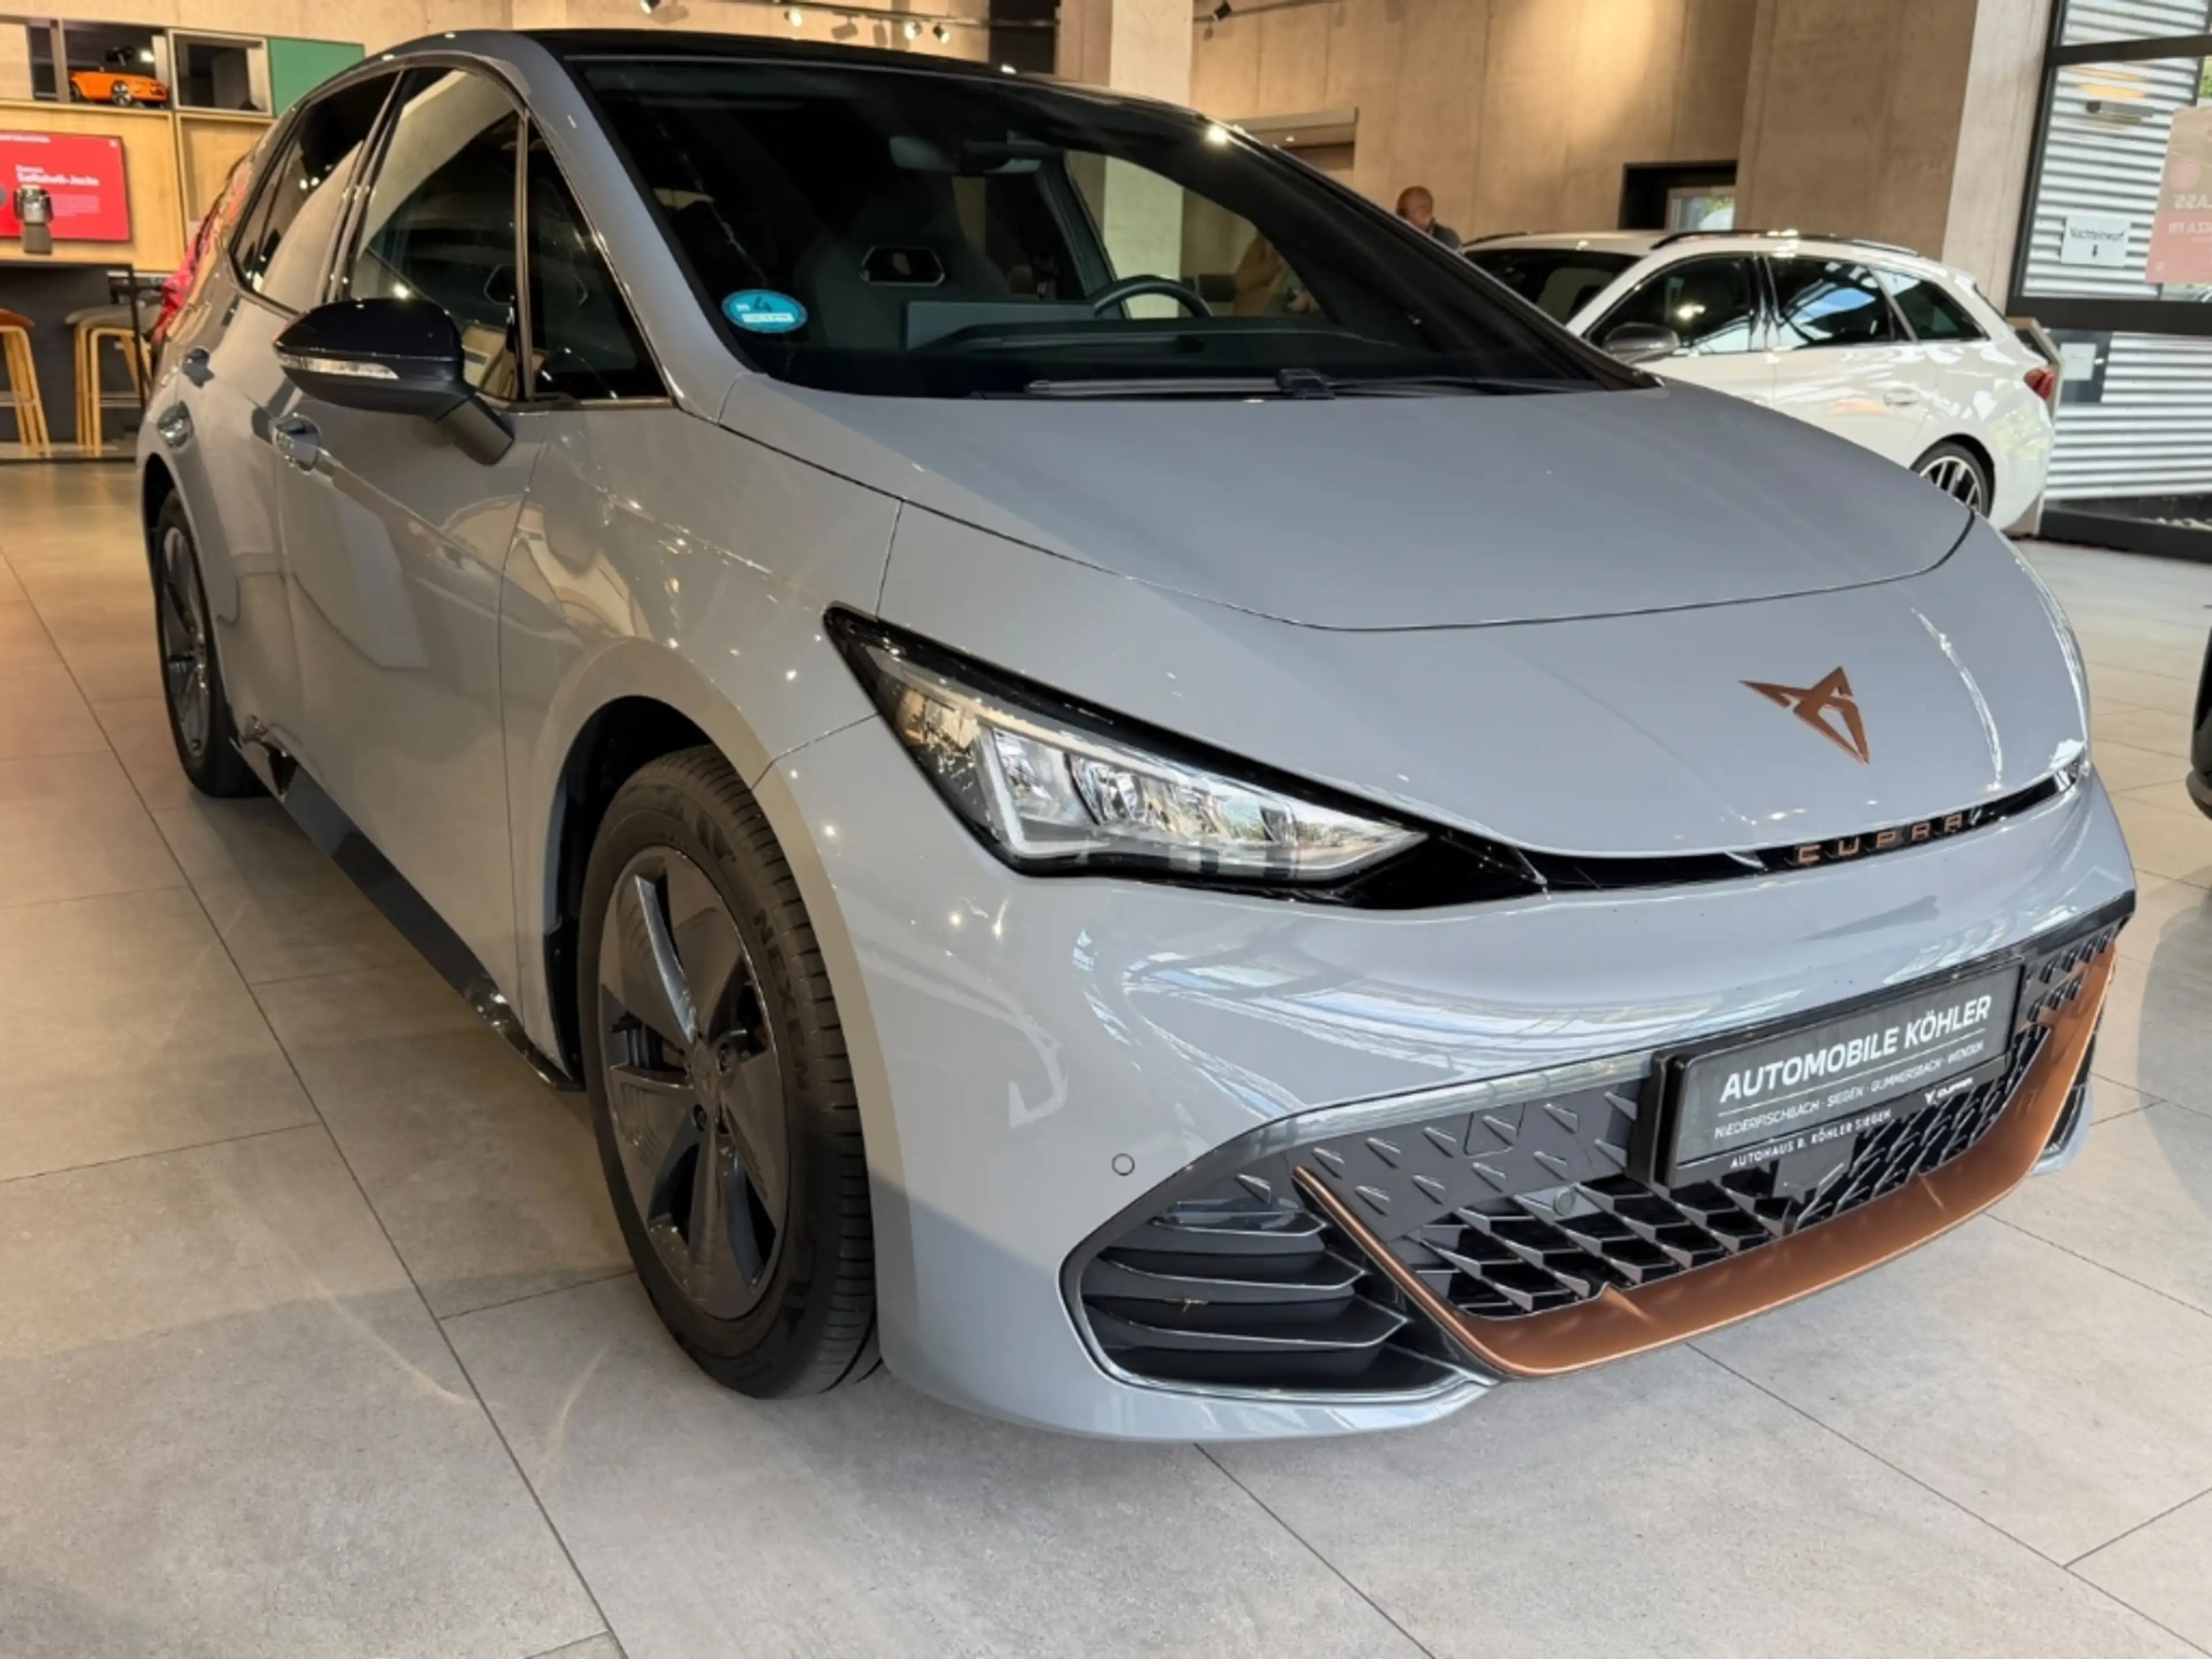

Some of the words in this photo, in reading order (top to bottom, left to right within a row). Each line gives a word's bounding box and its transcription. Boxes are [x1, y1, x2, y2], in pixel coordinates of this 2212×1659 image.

[1798, 813, 1962, 863] CUPRA
[1719, 1026, 1900, 1104] AUTOMOBILE
[1904, 994, 1993, 1049] KÖHLER
[1827, 1085, 1865, 1108] SIEGEN
[1870, 1057, 1943, 1093] GUMMERSBACH
[1730, 1141, 1794, 1169] AUTOHAUS
[1810, 1127, 1853, 1145] KÖHLER
[1855, 1108, 1892, 1131] SIEGEN
